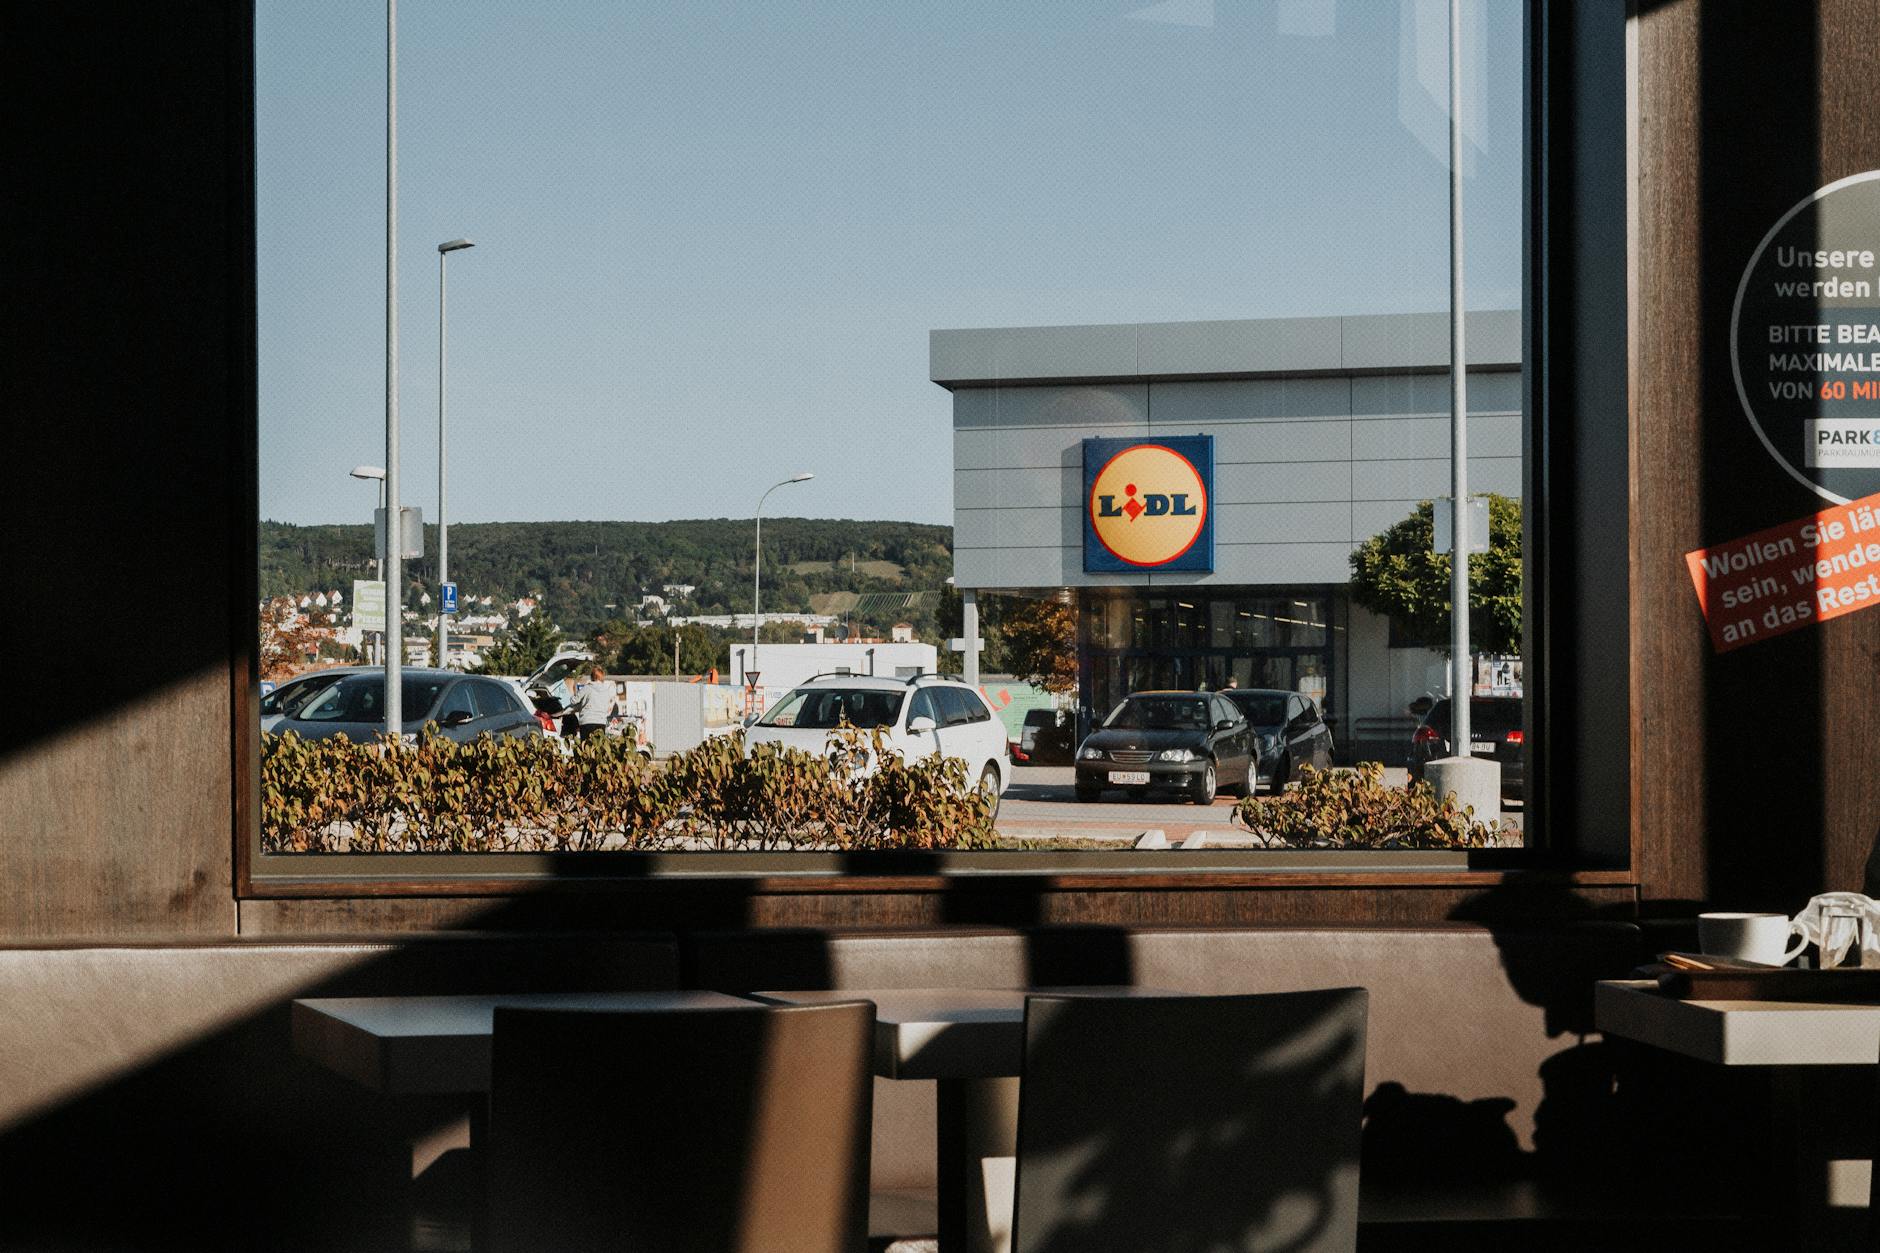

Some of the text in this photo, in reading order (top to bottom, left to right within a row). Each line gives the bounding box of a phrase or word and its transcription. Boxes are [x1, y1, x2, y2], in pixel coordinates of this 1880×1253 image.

[1777, 245, 1875, 268] Unsere
[1774, 275, 1870, 298] werden
[1769, 324, 1831, 344] BITTE
[1769, 352, 1880, 372] MAXIMALE
[1768, 379, 1880, 401] VON 60 MI
[1701, 537, 1796, 579] Wollen
[1800, 520, 1846, 548] Sie
[1722, 543, 1880, 609] sein, wende
[1722, 573, 1880, 643] an das Rest
